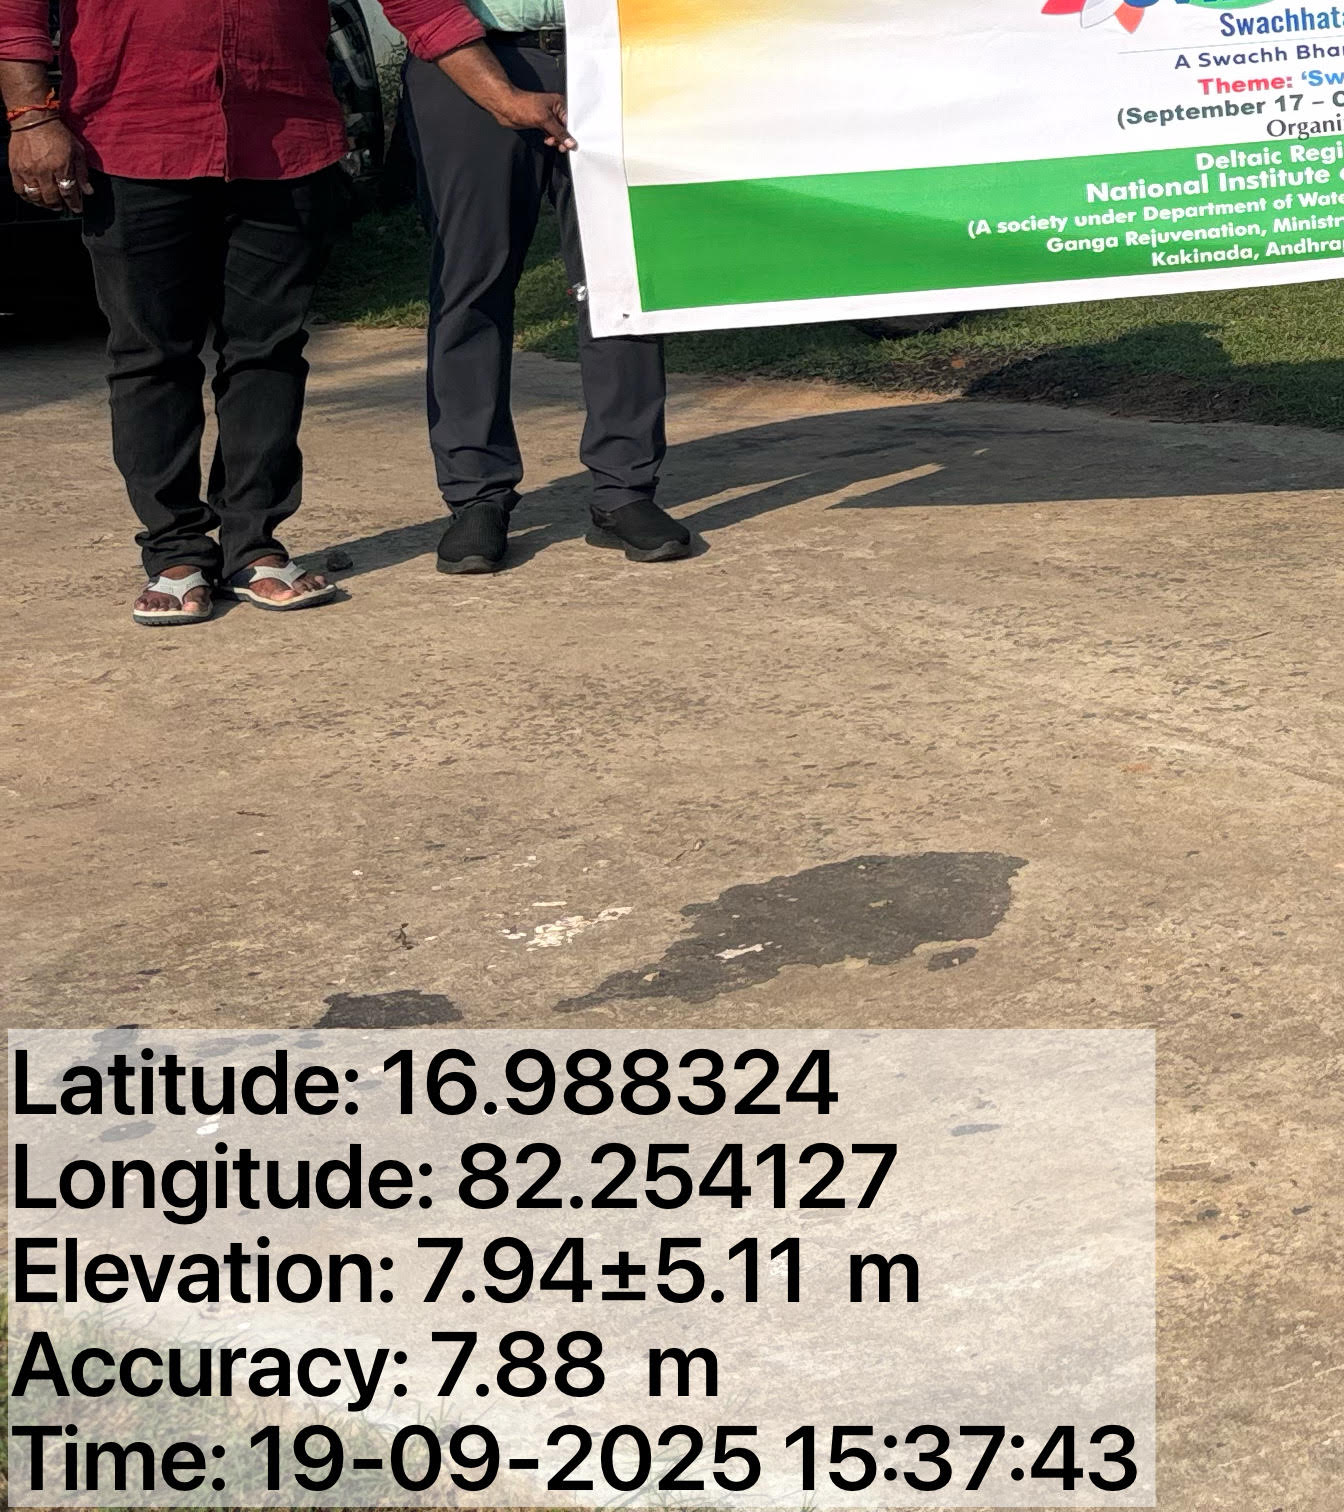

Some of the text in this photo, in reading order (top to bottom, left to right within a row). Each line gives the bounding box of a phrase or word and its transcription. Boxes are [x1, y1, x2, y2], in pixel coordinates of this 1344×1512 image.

[1174, 54, 1191, 70] A
[1198, 47, 1288, 69] Swachh
[1198, 76, 1293, 96] Theme:
[1117, 99, 1265, 129] (September
[1275, 94, 1303, 111] 17
[1196, 147, 1282, 172] Deltaic
[1086, 173, 1208, 203] National
[1219, 163, 1330, 192] Institute
[968, 220, 992, 239] (A
[997, 214, 1068, 234] society
[1075, 209, 1137, 228] under
[1143, 199, 1267, 223] Department
[1273, 193, 1294, 210] of
[1047, 234, 1118, 253] Ganga
[1126, 222, 1267, 248] Rejuvenation,
[1152, 245, 1260, 267] Kakinada,
